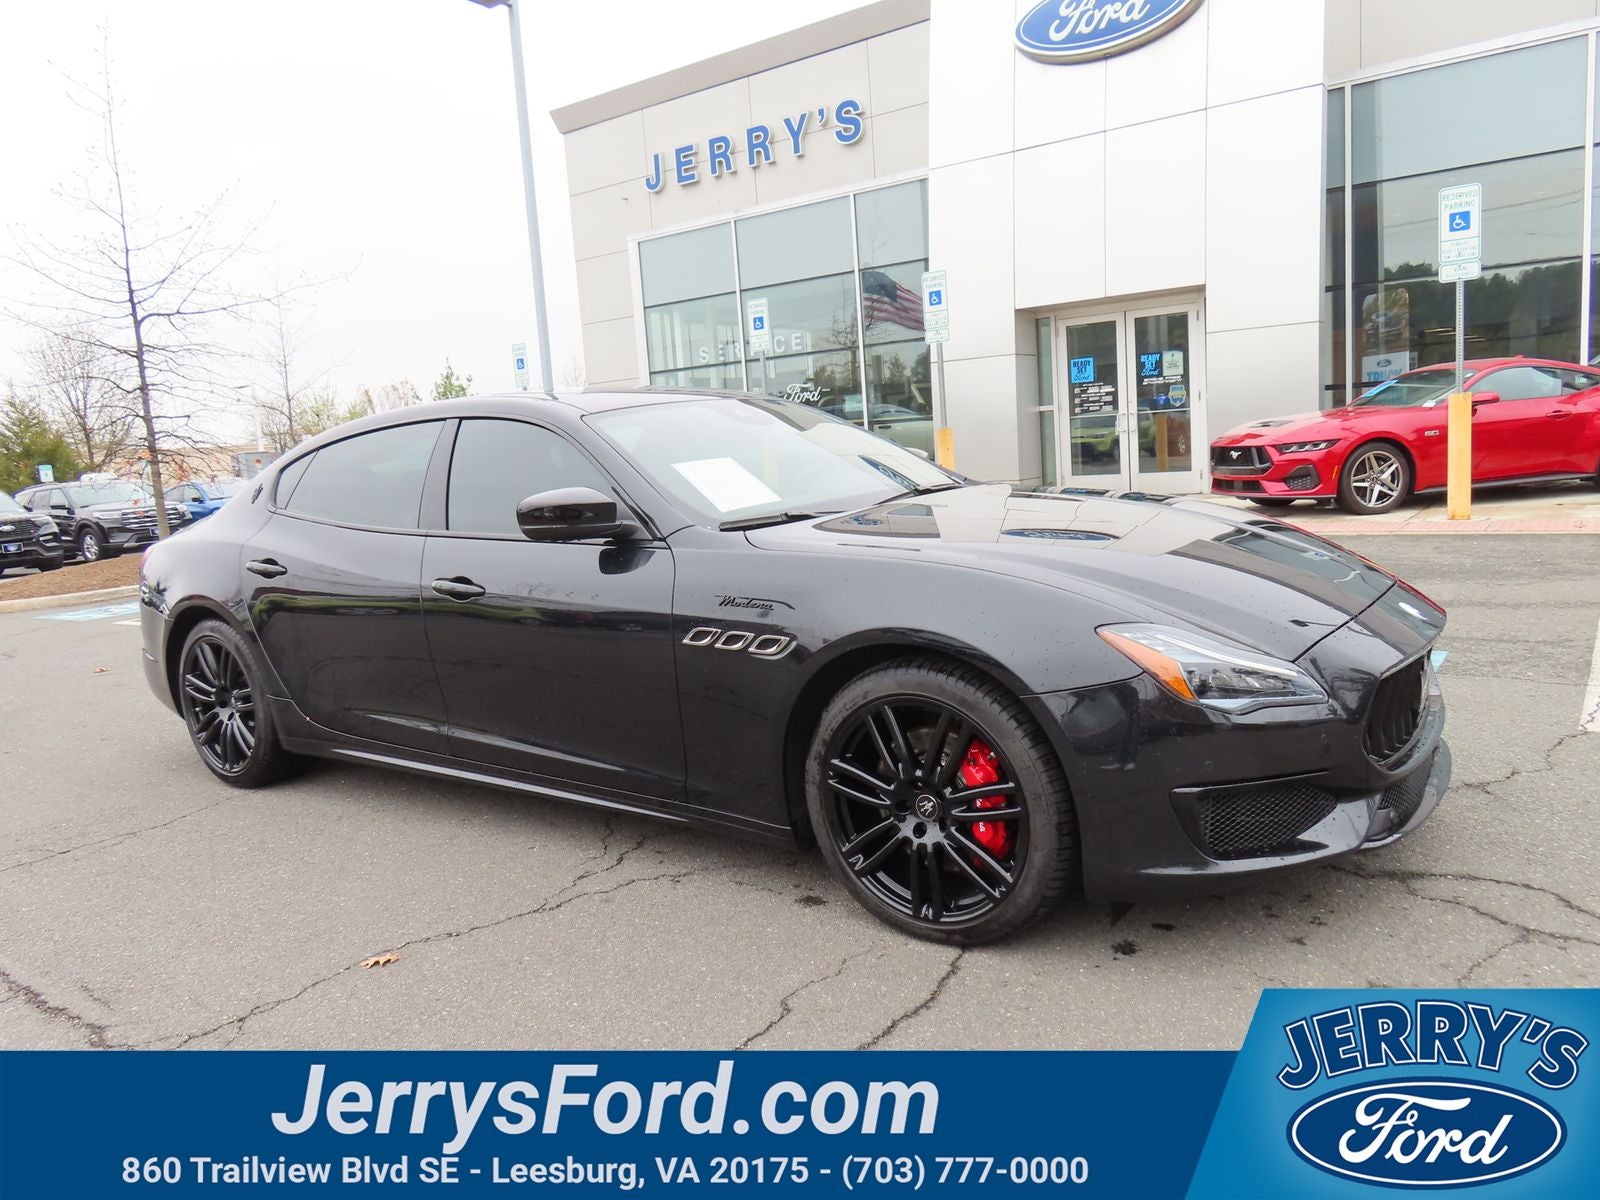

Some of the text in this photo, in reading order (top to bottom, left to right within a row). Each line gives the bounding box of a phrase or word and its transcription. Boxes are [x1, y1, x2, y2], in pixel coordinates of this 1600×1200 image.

[645, 99, 865, 193] JERRY'S
[1441, 190, 1478, 202] RESERVED
[1444, 200, 1476, 210] PARKING
[1072, 359, 1091, 368] READY
[1076, 366, 1087, 374] SET
[783, 383, 821, 403] Ford
[714, 595, 795, 611] Modena
